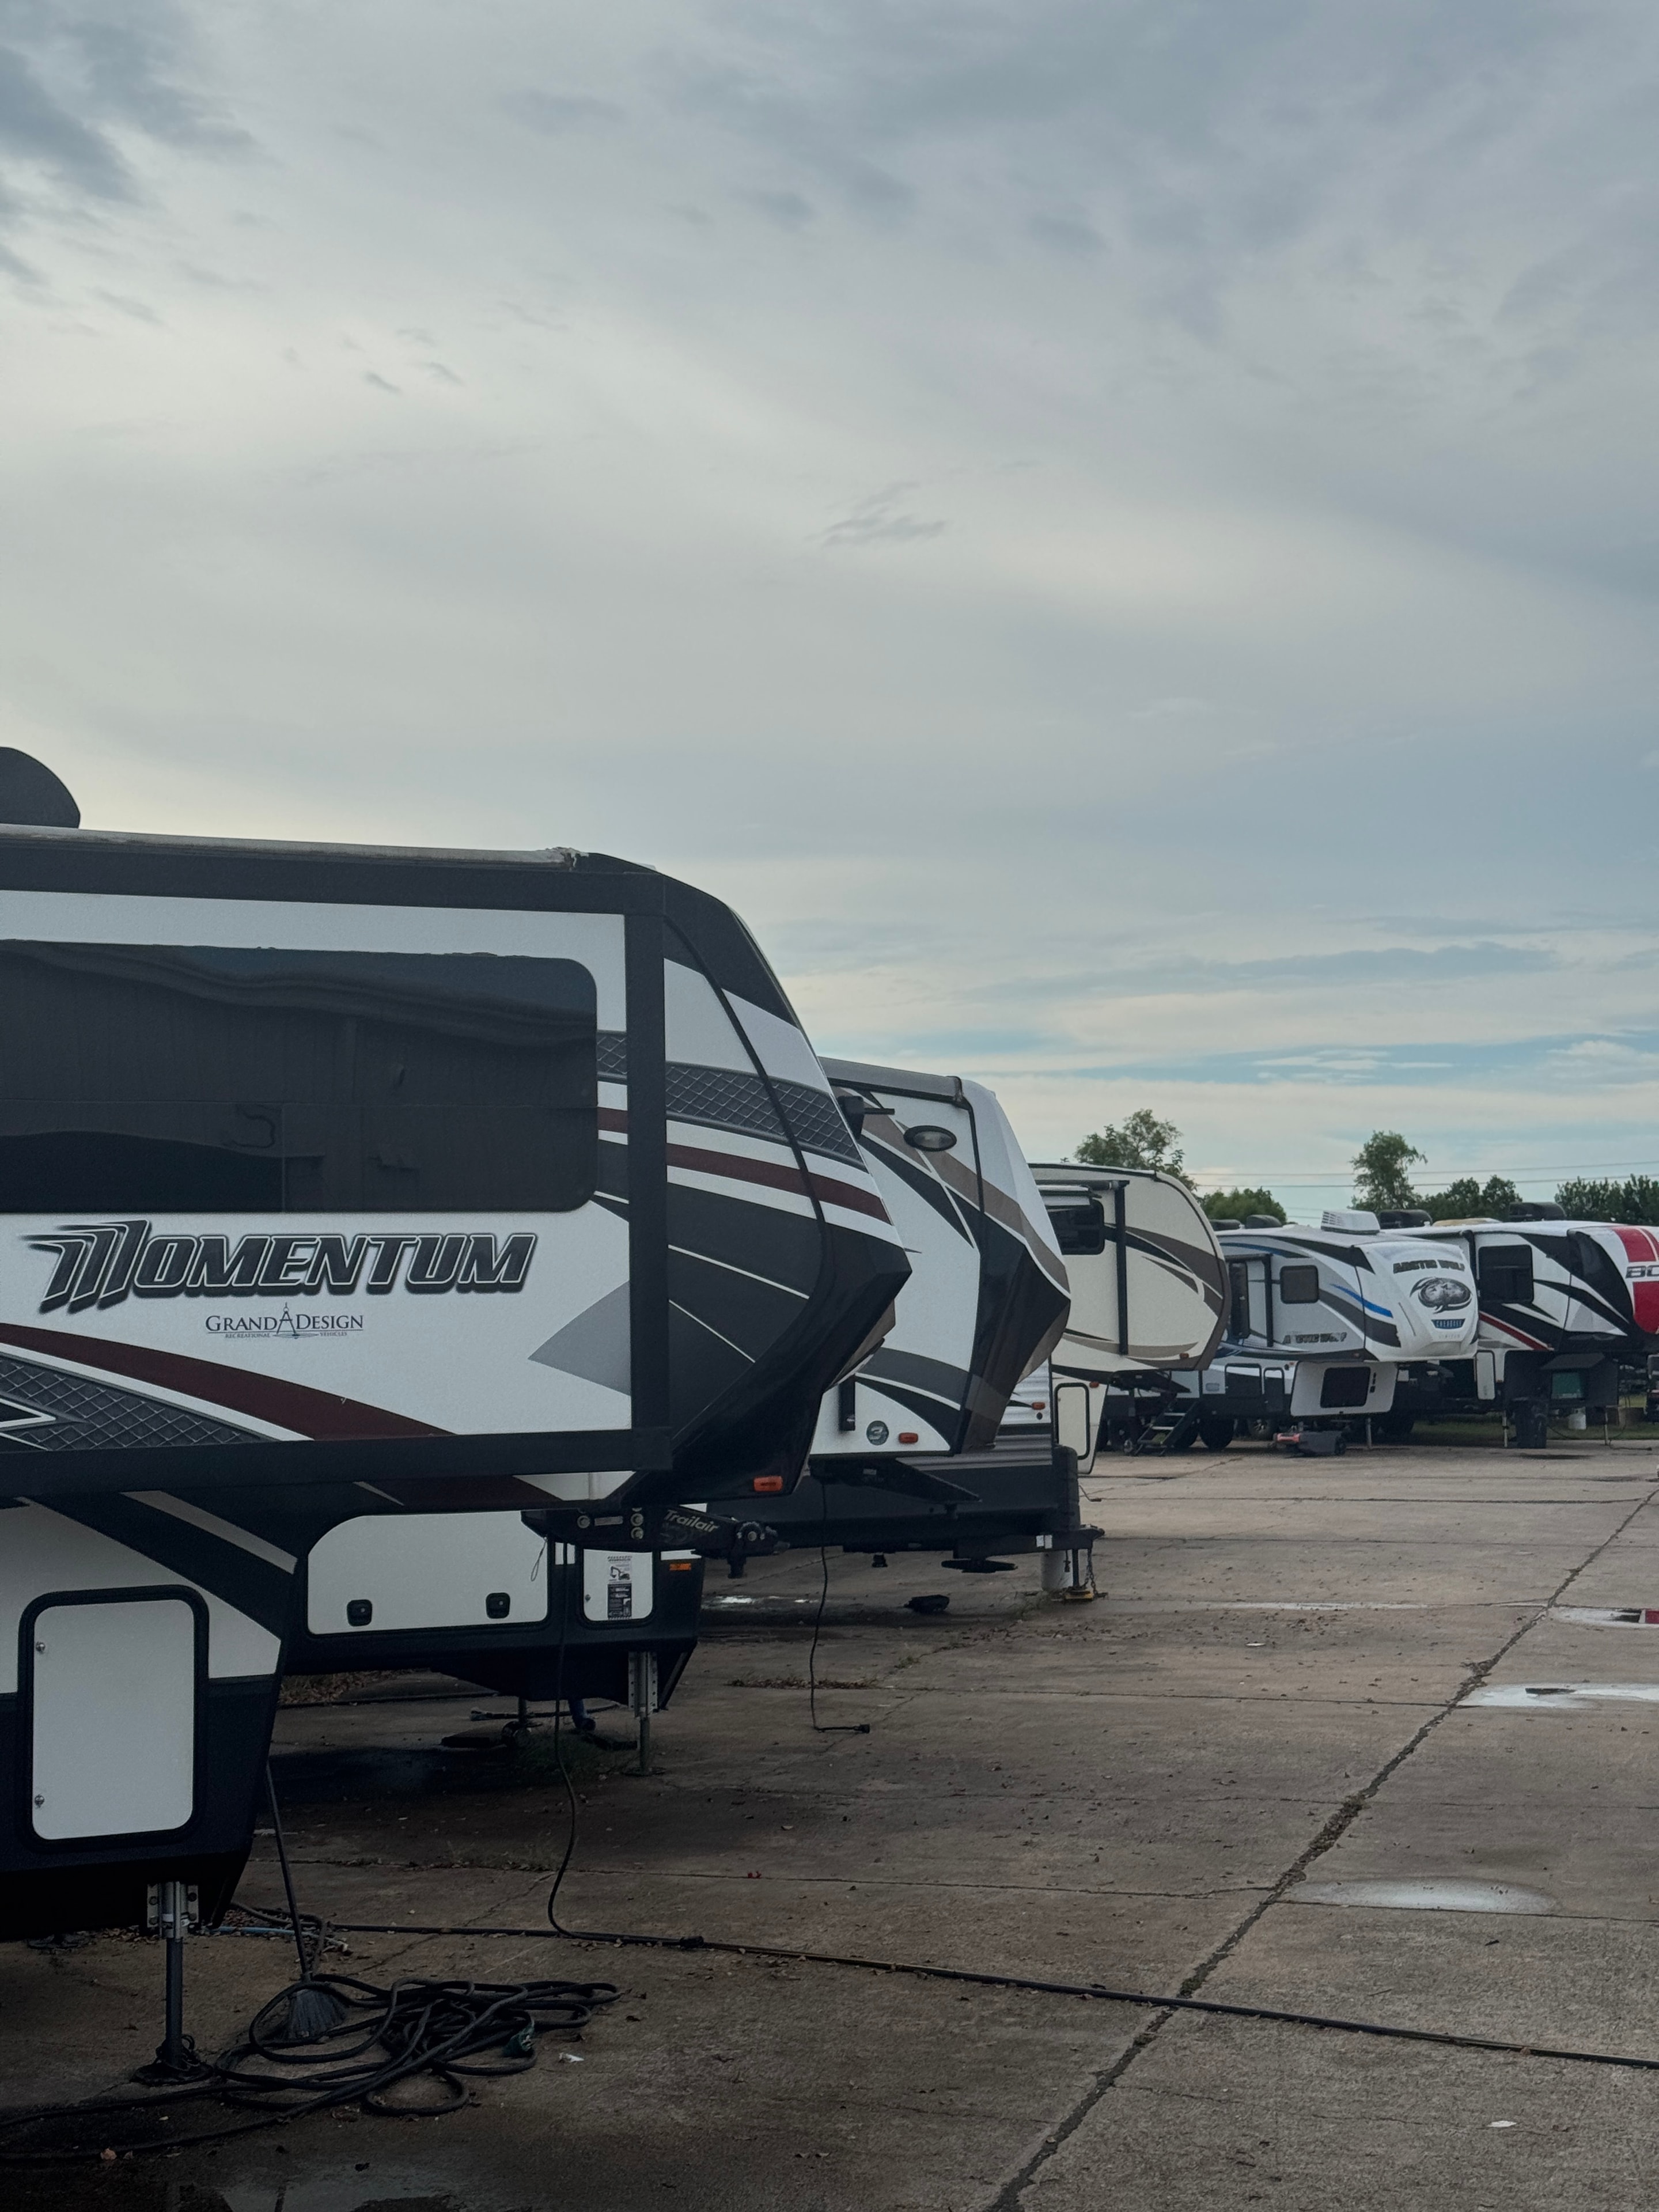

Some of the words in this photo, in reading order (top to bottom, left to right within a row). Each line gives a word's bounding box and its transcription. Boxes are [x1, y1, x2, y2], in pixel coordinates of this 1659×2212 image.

[18, 1218, 538, 1315] MOMENTUM
[206, 1315, 278, 1331] GRAND
[295, 1314, 363, 1330] DESIGN
[663, 1509, 720, 1532] Trailair
